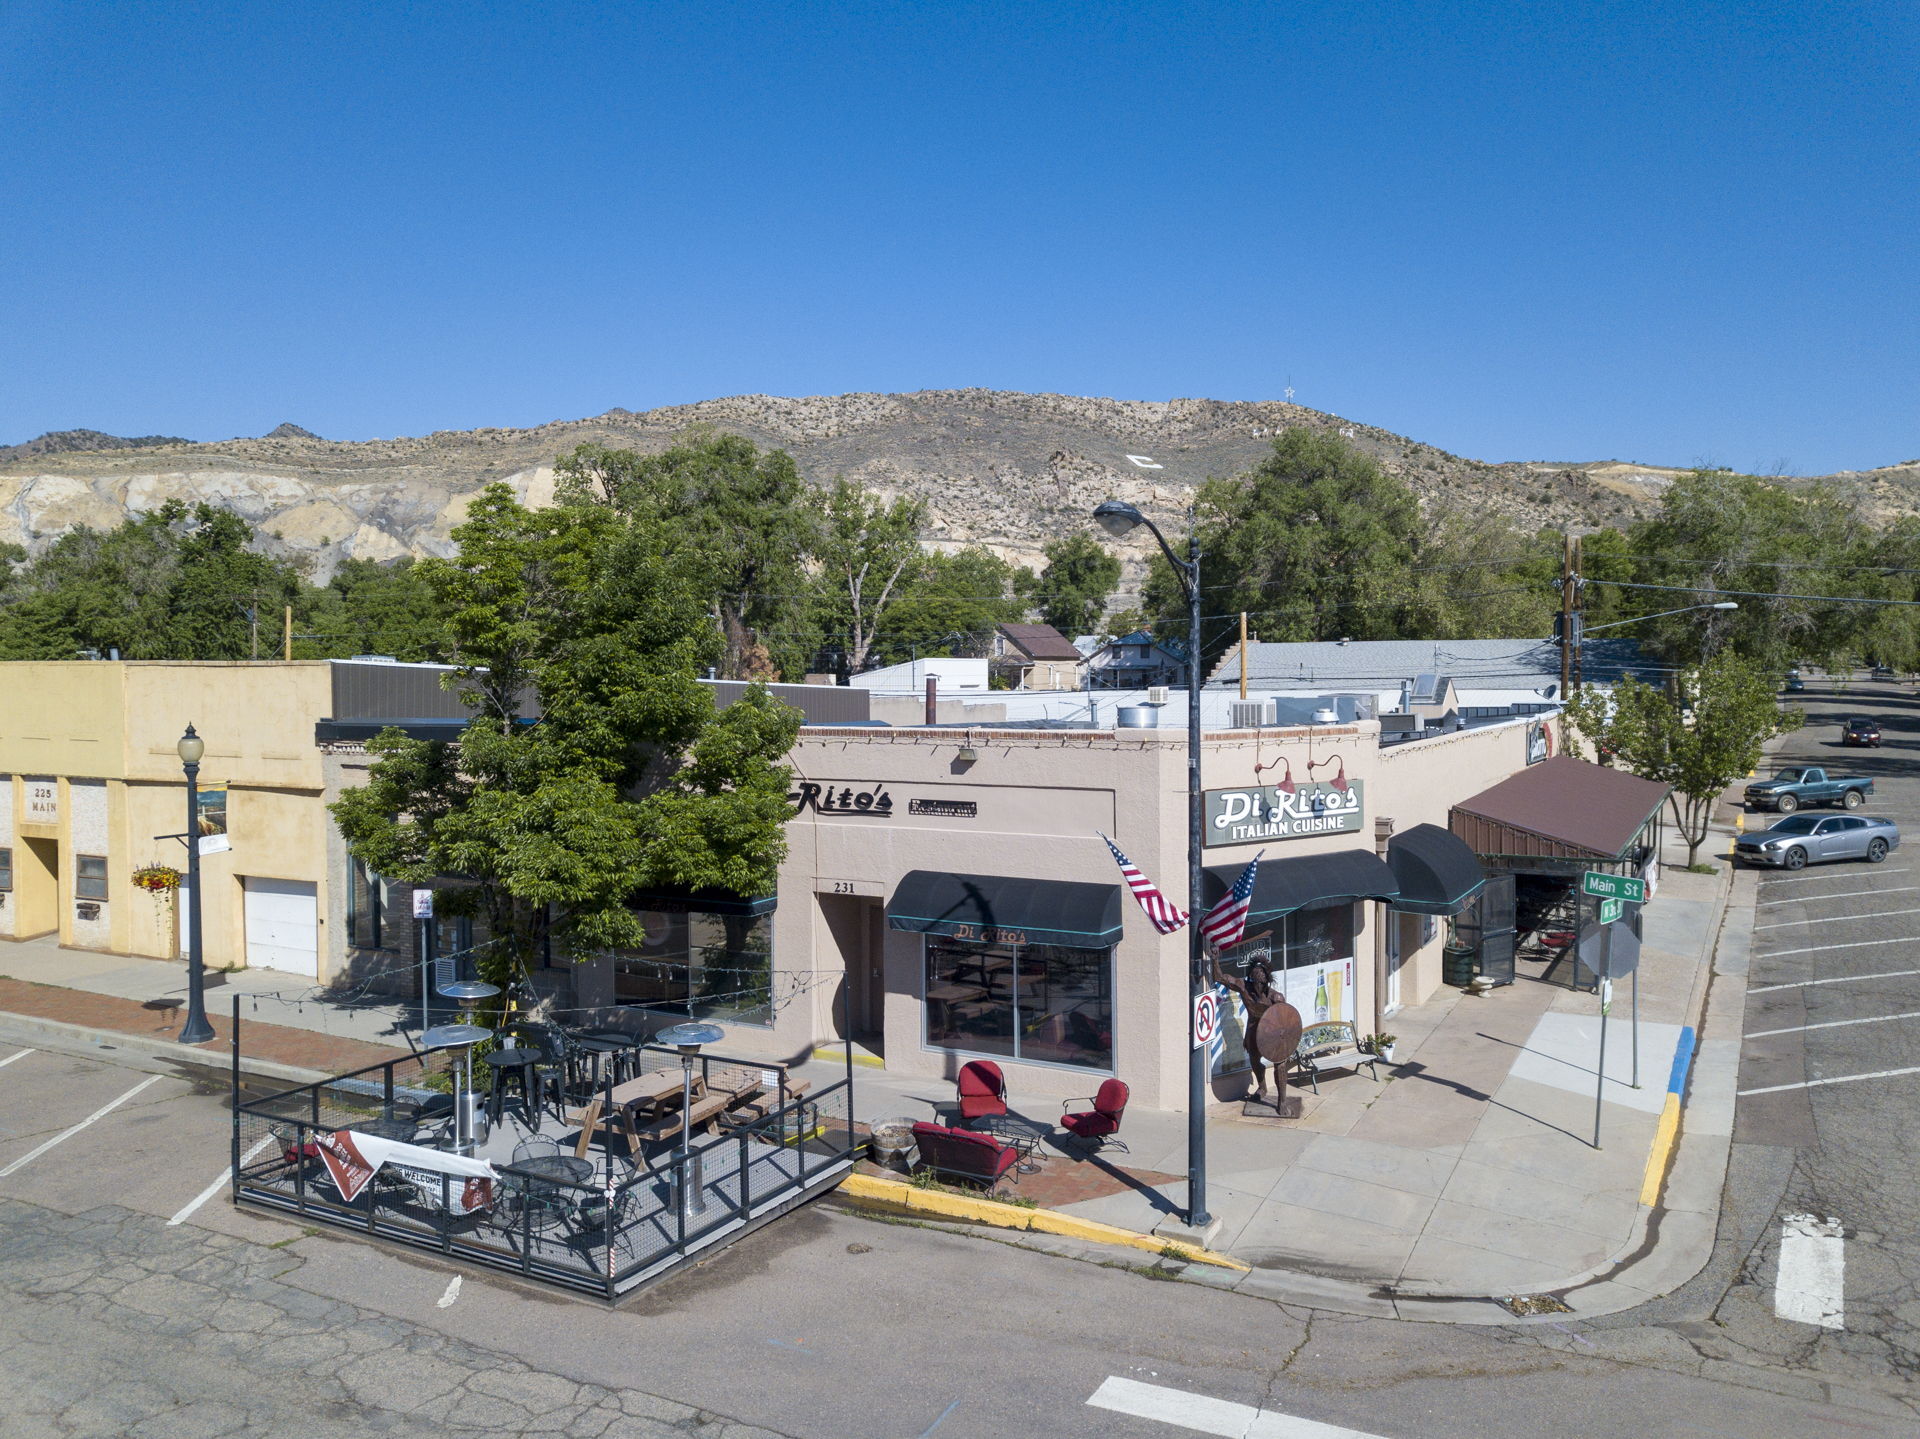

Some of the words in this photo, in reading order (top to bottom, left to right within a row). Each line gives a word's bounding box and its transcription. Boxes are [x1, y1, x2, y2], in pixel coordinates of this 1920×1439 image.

[35, 788, 51, 798] 225
[32, 802, 57, 812] MAIN
[1214, 792, 1263, 830] Di
[1266, 787, 1360, 824] Rito's
[1231, 820, 1289, 840] ITALIAN
[1292, 815, 1345, 834] CUISINE
[834, 882, 855, 894] 231
[1589, 876, 1616, 893] Main
[1623, 882, 1639, 897] St
[953, 924, 976, 940] Di
[404, 1170, 442, 1187] WELCOME
